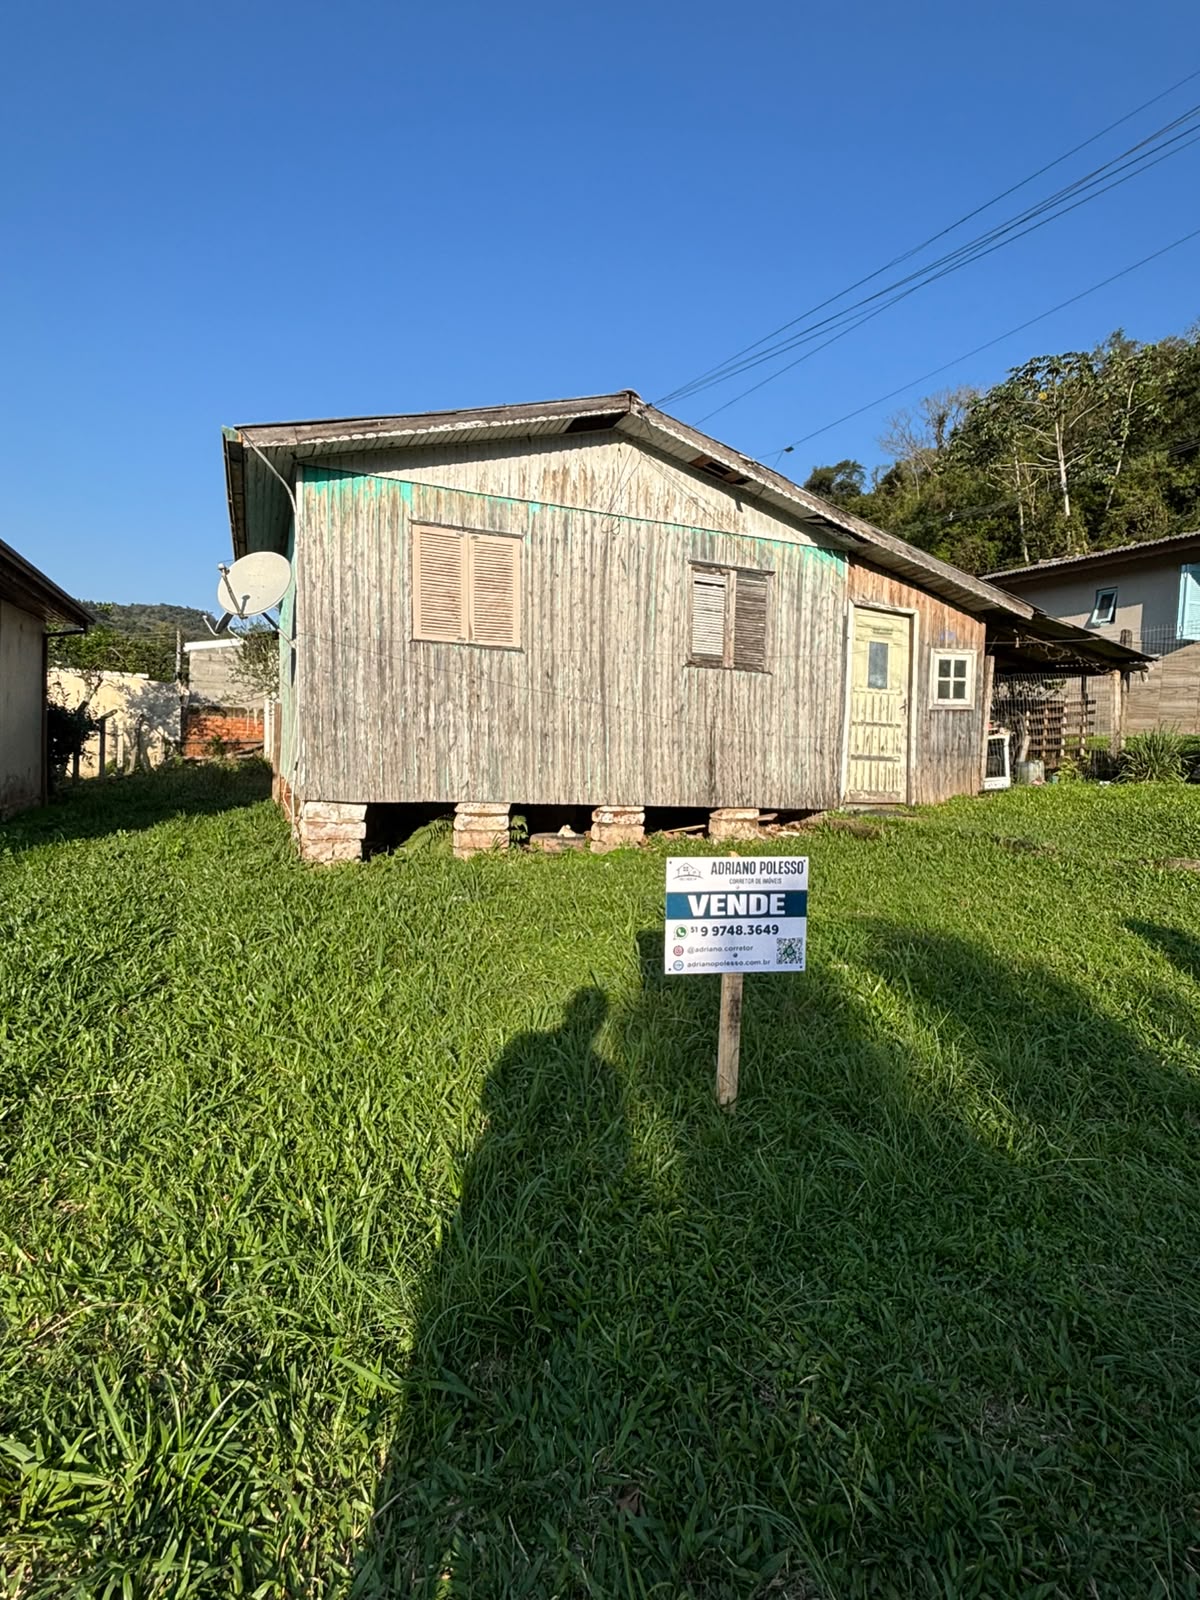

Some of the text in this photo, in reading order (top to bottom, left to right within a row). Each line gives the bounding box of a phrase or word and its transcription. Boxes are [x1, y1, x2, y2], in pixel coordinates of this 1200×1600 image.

[711, 861, 804, 875] ADRIANO POLESSO
[687, 893, 786, 917] VENDE
[701, 926, 708, 936] 9
[712, 924, 779, 936] 9748.3649
[687, 945, 753, 954] @adriano.corretor
[687, 959, 770, 969] adrianopolesso.com.br
